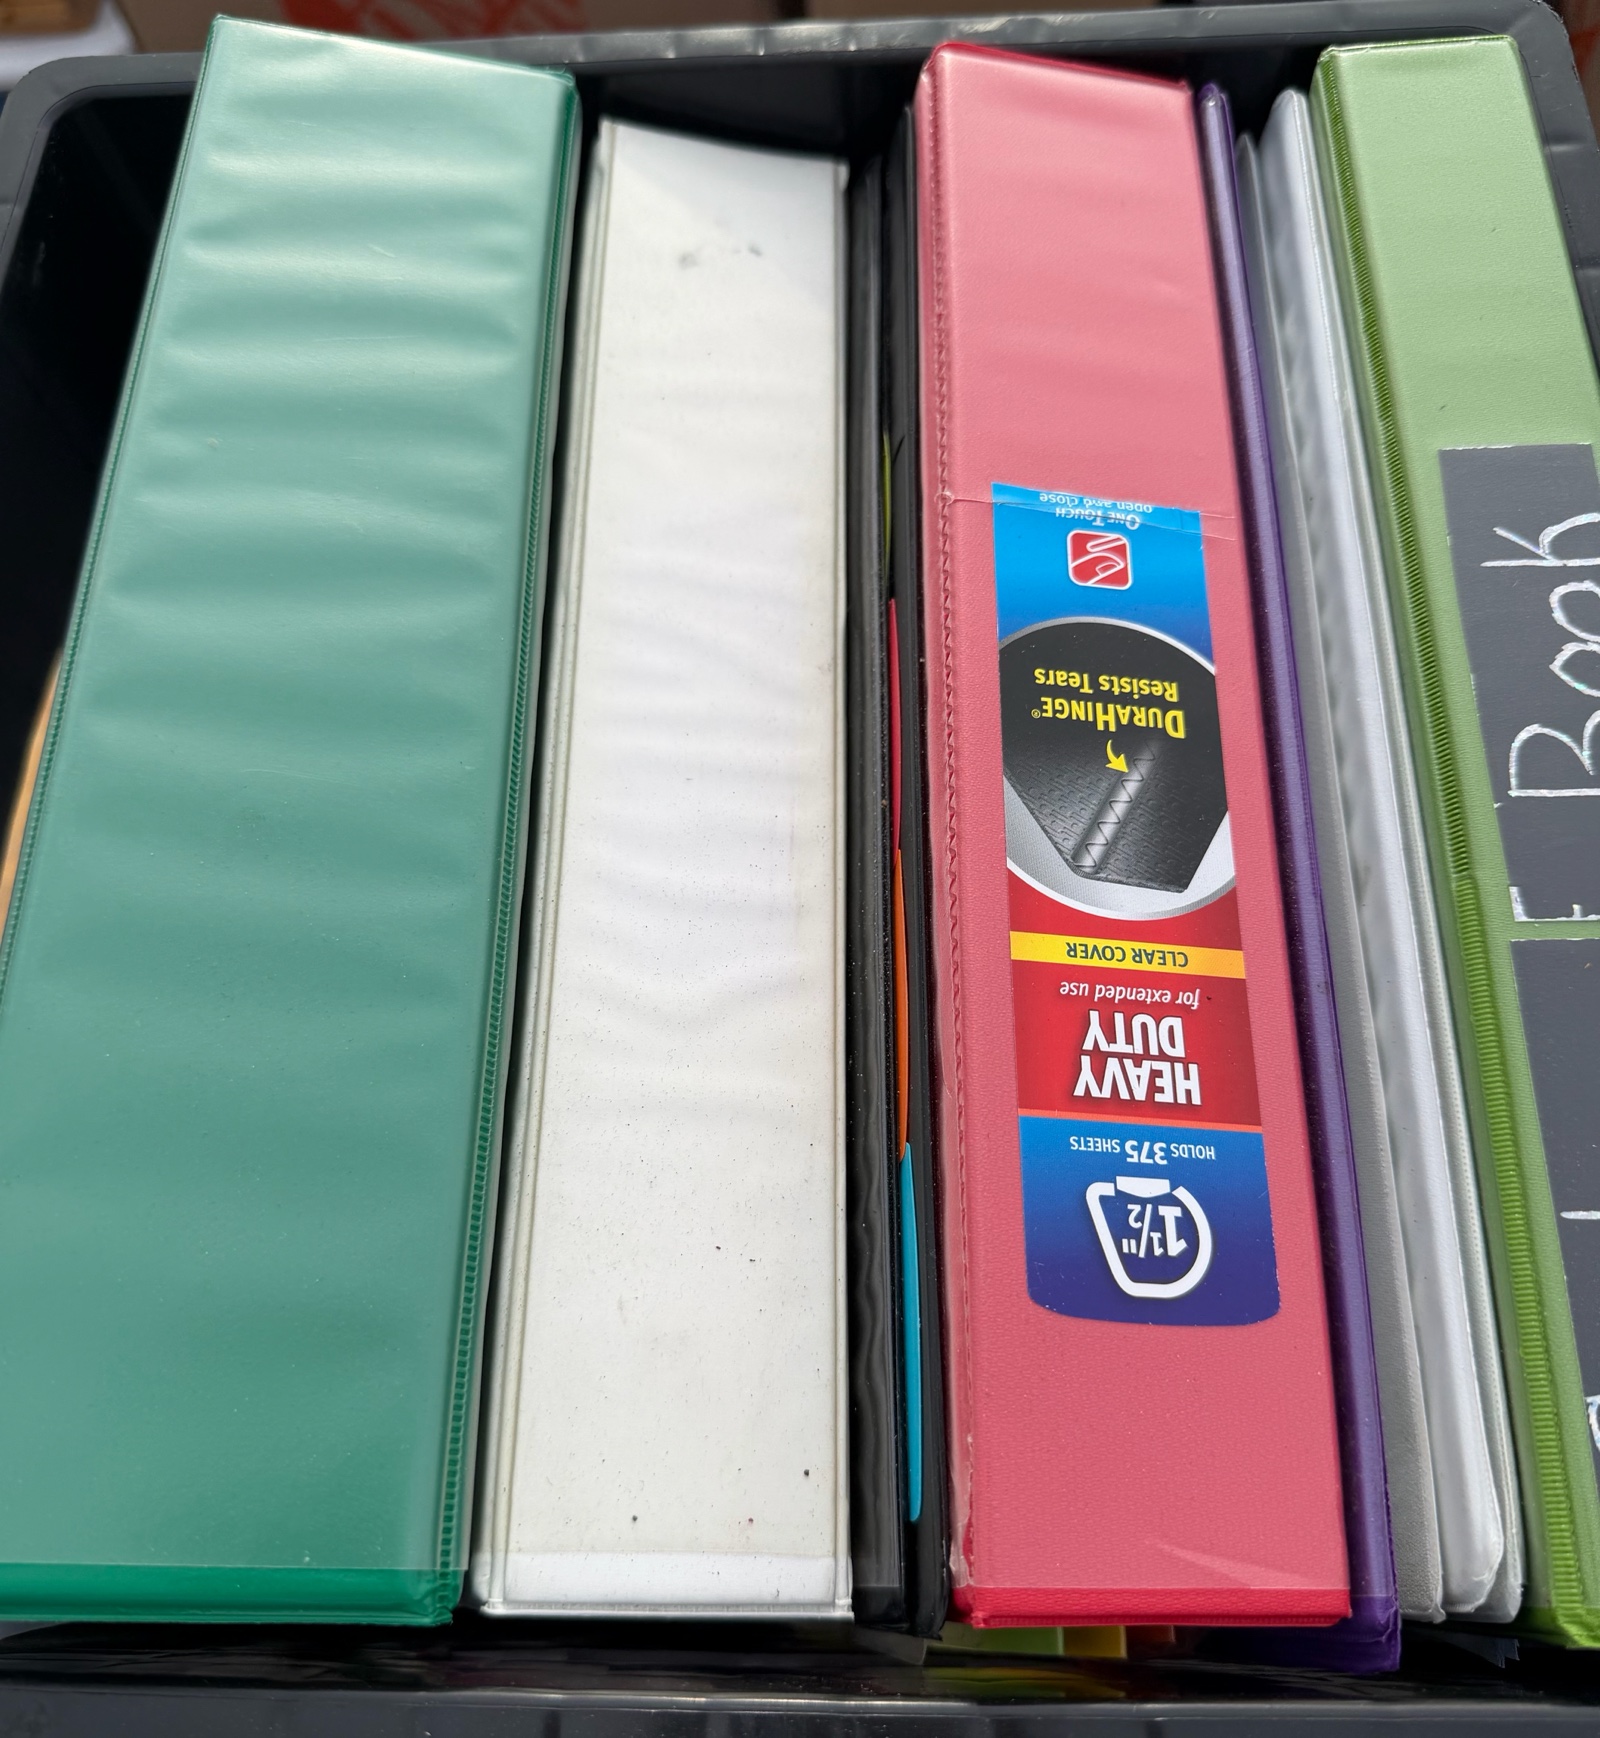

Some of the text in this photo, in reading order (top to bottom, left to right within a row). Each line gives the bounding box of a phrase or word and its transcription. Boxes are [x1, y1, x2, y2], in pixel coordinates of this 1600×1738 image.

[1039, 491, 1079, 509] close
[1034, 668, 1180, 703] Resists Tears
[1065, 942, 1189, 968] CLEAR COVER
[1060, 981, 1201, 1010] for extended use
[1082, 1010, 1186, 1058] DUTY
[1073, 1055, 1202, 1106] HEAVY
[1069, 1136, 1216, 1165] HOLDS 375 SHEETS
